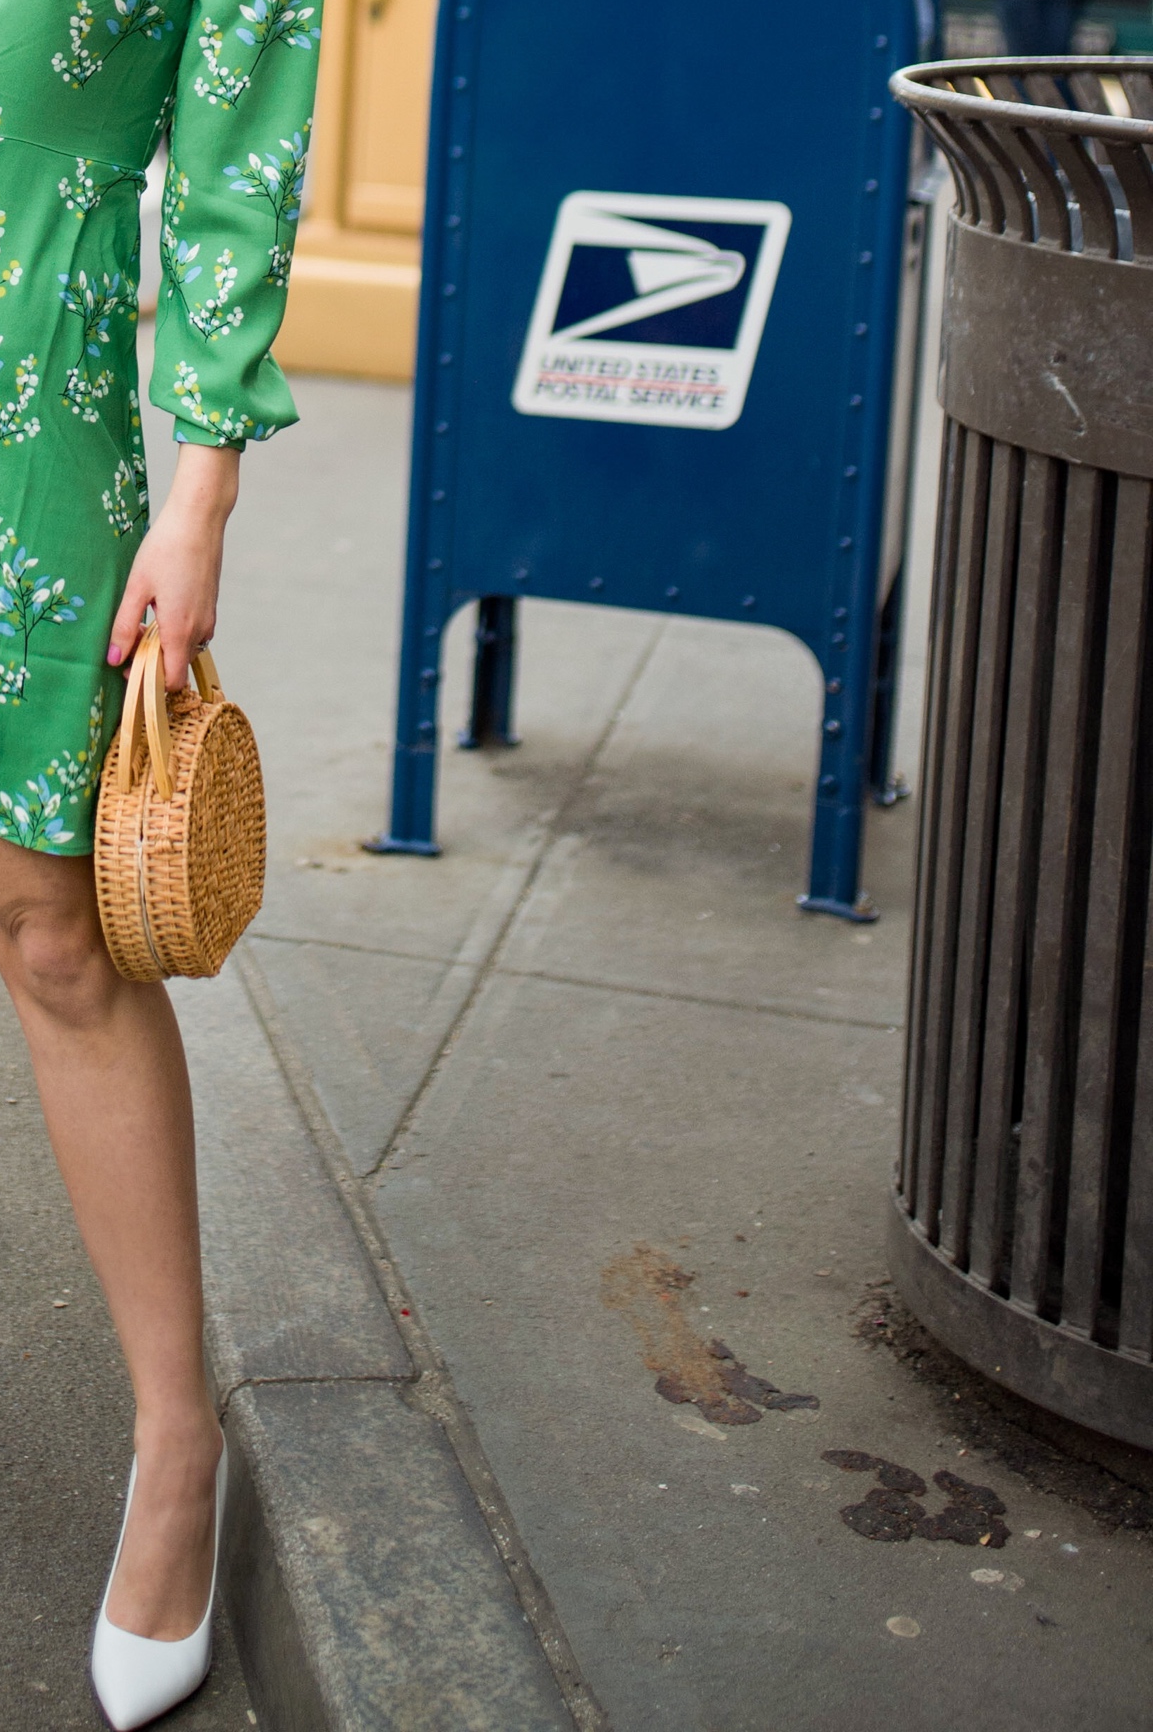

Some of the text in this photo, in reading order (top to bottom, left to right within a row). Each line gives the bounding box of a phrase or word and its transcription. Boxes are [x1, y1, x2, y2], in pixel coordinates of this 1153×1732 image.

[541, 354, 720, 383] UNITED STATES
[534, 380, 725, 409] POSTAL SERVICE
